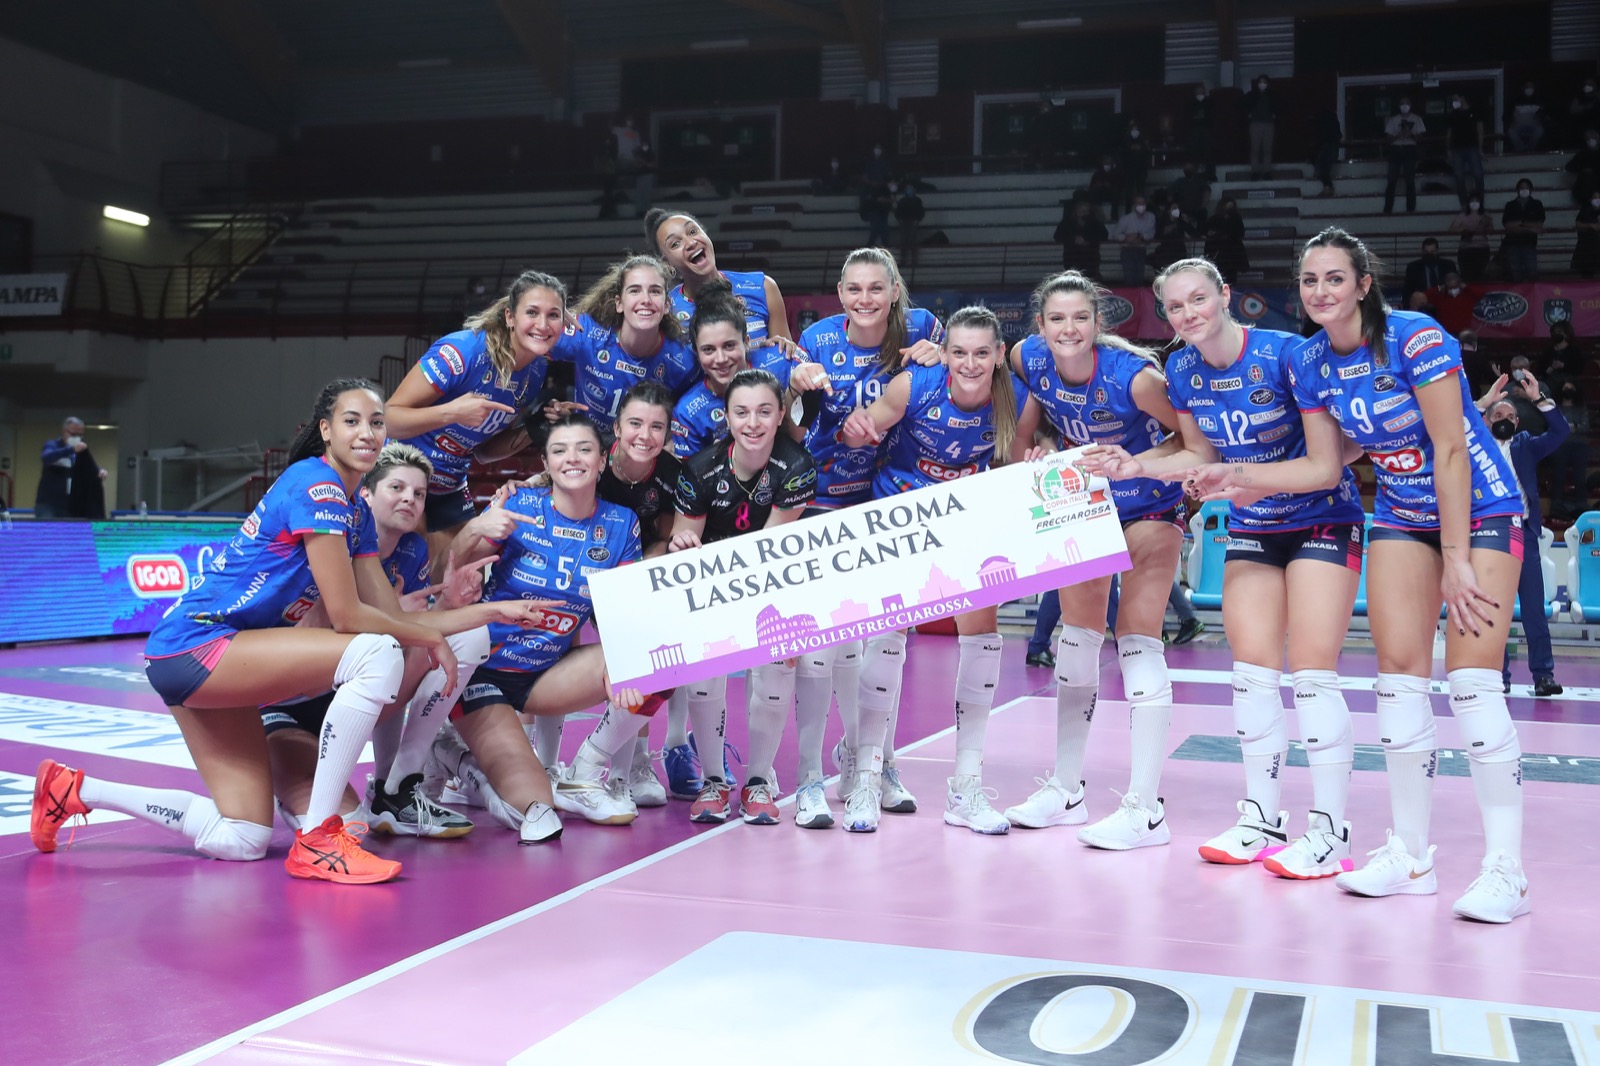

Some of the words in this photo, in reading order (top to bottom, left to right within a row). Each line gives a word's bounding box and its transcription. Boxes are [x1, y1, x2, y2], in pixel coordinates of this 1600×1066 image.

[1405, 330, 1442, 358] sterilgarda
[585, 364, 614, 382] MIKASA
[624, 364, 645, 376] ESSECO
[1343, 365, 1369, 378] ESSECO
[1413, 354, 1452, 376] MIKASA
[855, 378, 881, 407] 19
[1217, 379, 1241, 390] ESSECO
[1187, 397, 1215, 407] MIKASA
[1350, 397, 1374, 434] 9
[1061, 415, 1090, 442] 10
[1220, 409, 1257, 446] 12
[945, 441, 961, 459] 4
[1462, 415, 1509, 498] OLINES
[922, 464, 973, 479] IGOR
[1407, 476, 1432, 486] BPM
[784, 489, 815, 503] MIKASA
[1046, 499, 1069, 510] COPPA
[1069, 493, 1089, 503] ITALIA
[735, 501, 751, 531] 8
[1036, 504, 1111, 530] FRECCIAROSSA
[521, 532, 553, 548] MIKASA
[647, 549, 749, 592] ROMA
[755, 521, 857, 564] ROMA
[863, 492, 966, 536] ROMA
[1469, 529, 1499, 537] KASA
[1301, 540, 1338, 551] MIKASA
[135, 565, 182, 588] IGOR
[513, 569, 545, 586] COLINES
[555, 556, 574, 591] 5
[685, 558, 824, 613] LASSACE
[832, 525, 944, 572] CANTÀ
[507, 634, 542, 651] BANCO
[542, 643, 562, 653] BPM
[1061, 638, 1079, 647] MIKASA
[1122, 649, 1143, 658] MIKASA
[1453, 693, 1478, 702] MIKASA
[718, 709, 727, 738] MIKASA
[319, 721, 335, 760] MIKASA
[1424, 750, 1437, 779] MIKA
[146, 803, 184, 824] MIKASA
